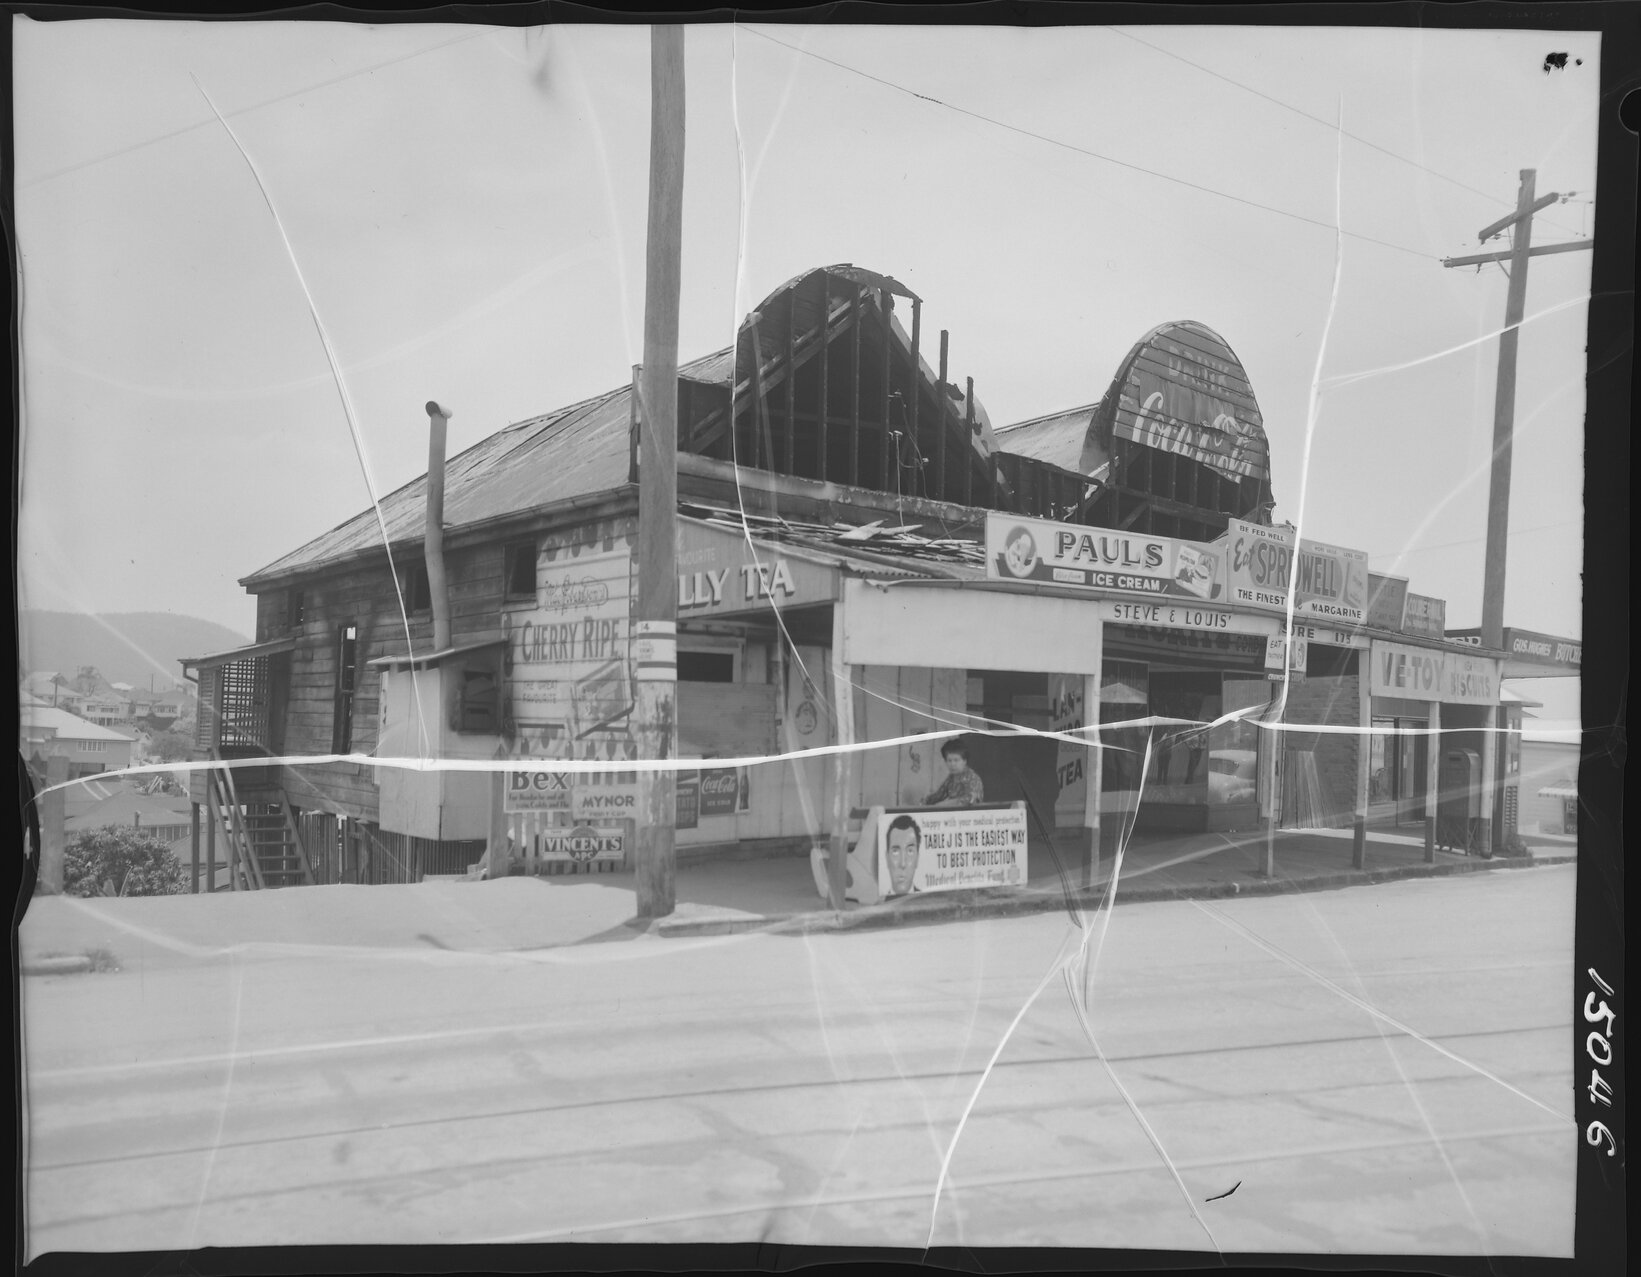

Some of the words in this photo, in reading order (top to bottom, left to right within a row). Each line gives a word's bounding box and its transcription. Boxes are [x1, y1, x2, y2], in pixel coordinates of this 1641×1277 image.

[1252, 528, 1266, 537] FED
[1268, 532, 1285, 542] WELL
[1055, 531, 1164, 569] PAULS
[1233, 537, 1255, 572] Eat
[679, 567, 730, 610] LLY
[740, 559, 796, 602] TEA
[1092, 574, 1114, 587] ICE
[1117, 577, 1160, 592] CREAM
[1238, 589, 1253, 601] THE
[1256, 592, 1285, 605] FINEST
[1114, 604, 1160, 622] STEVE
[1169, 610, 1176, 623] &
[1185, 611, 1232, 628] LOUIS'
[1311, 603, 1362, 619] MARGARINE
[522, 620, 578, 661] CHERRY
[582, 616, 620, 659] RIPE
[1270, 639, 1283, 649] EAT
[1282, 624, 1315, 639] SORE
[1335, 632, 1351, 644] 175
[1451, 671, 1491, 698] BISCUITS
[511, 771, 569, 790] Bex
[1057, 758, 1083, 789] TEA
[582, 795, 635, 808] MYNOR
[544, 837, 622, 852] VINCENT'S
[923, 833, 945, 849] TABLE
[946, 832, 953, 848] J
[954, 832, 963, 848] IS
[965, 831, 979, 847] THE
[981, 828, 1009, 847] EASIEST
[1010, 828, 1025, 845] WAY
[574, 851, 594, 861] APC
[936, 852, 947, 869] TO
[950, 851, 969, 868] BEST
[971, 849, 1016, 867] PROTECTION
[924, 871, 957, 887] Medical
[1583, 967, 1617, 1157] 15046
